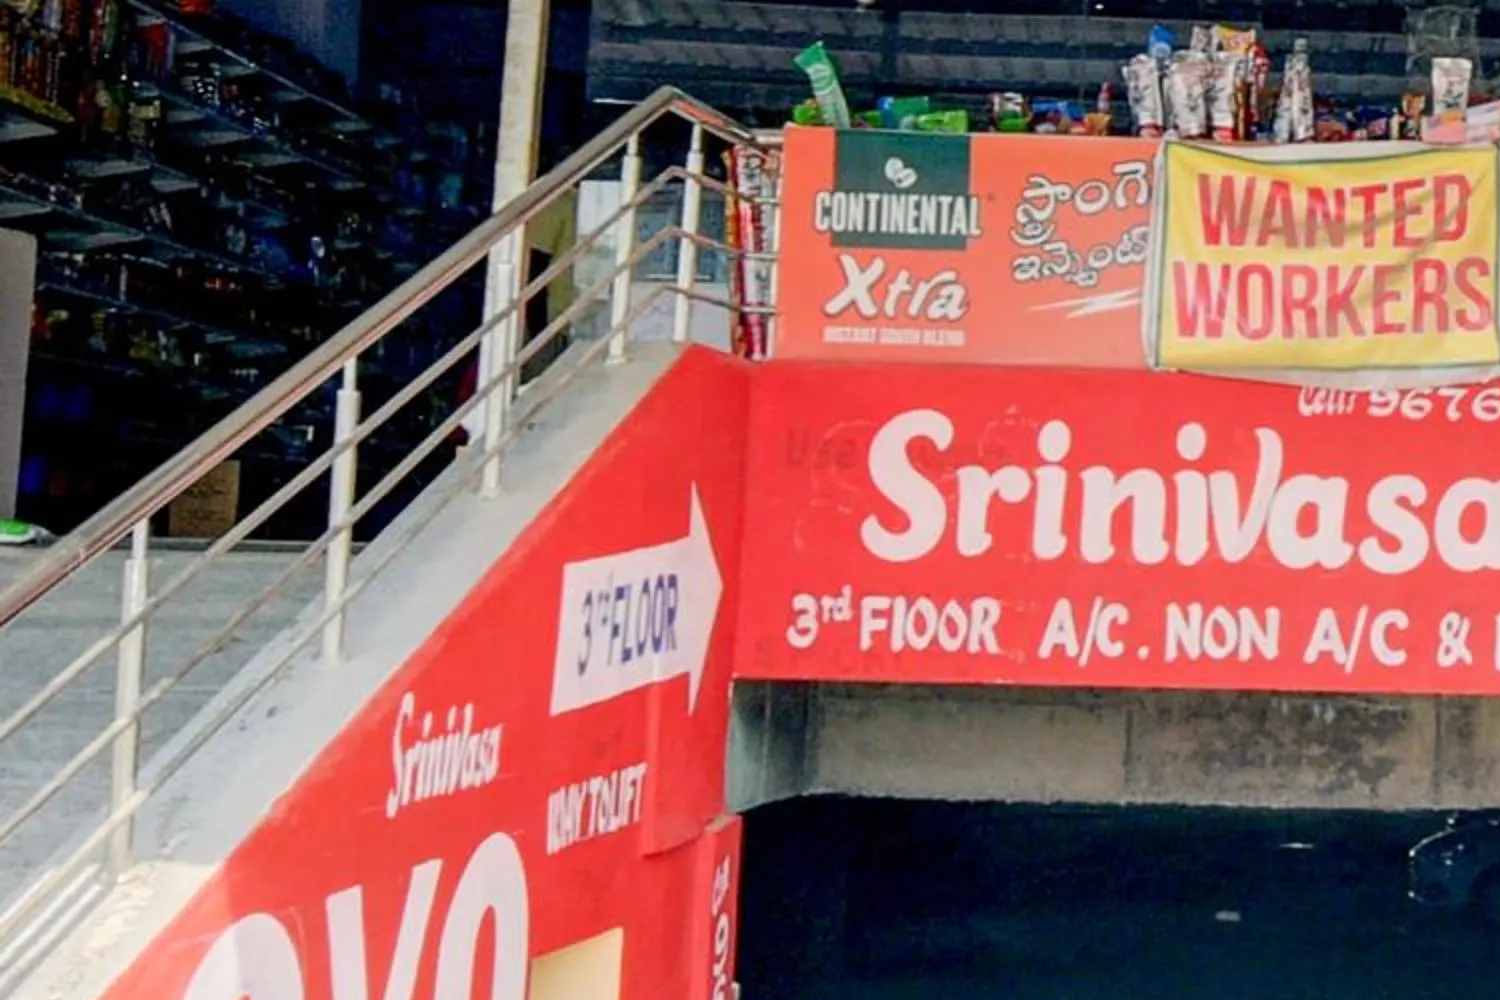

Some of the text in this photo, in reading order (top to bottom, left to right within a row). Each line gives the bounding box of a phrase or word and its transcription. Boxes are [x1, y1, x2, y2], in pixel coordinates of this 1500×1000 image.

[815, 191, 982, 236] CONTINENTAL
[1197, 173, 1470, 250] WANTED
[824, 253, 966, 321] Xtra
[1173, 256, 1491, 342] WORKERS
[607, 573, 678, 667] FLOOR
[786, 584, 852, 649] 3rd
[1164, 602, 1281, 662] NON
[1303, 605, 1410, 674] A/C
[1436, 613, 1473, 668] &
[385, 691, 503, 819] Srinivasa
